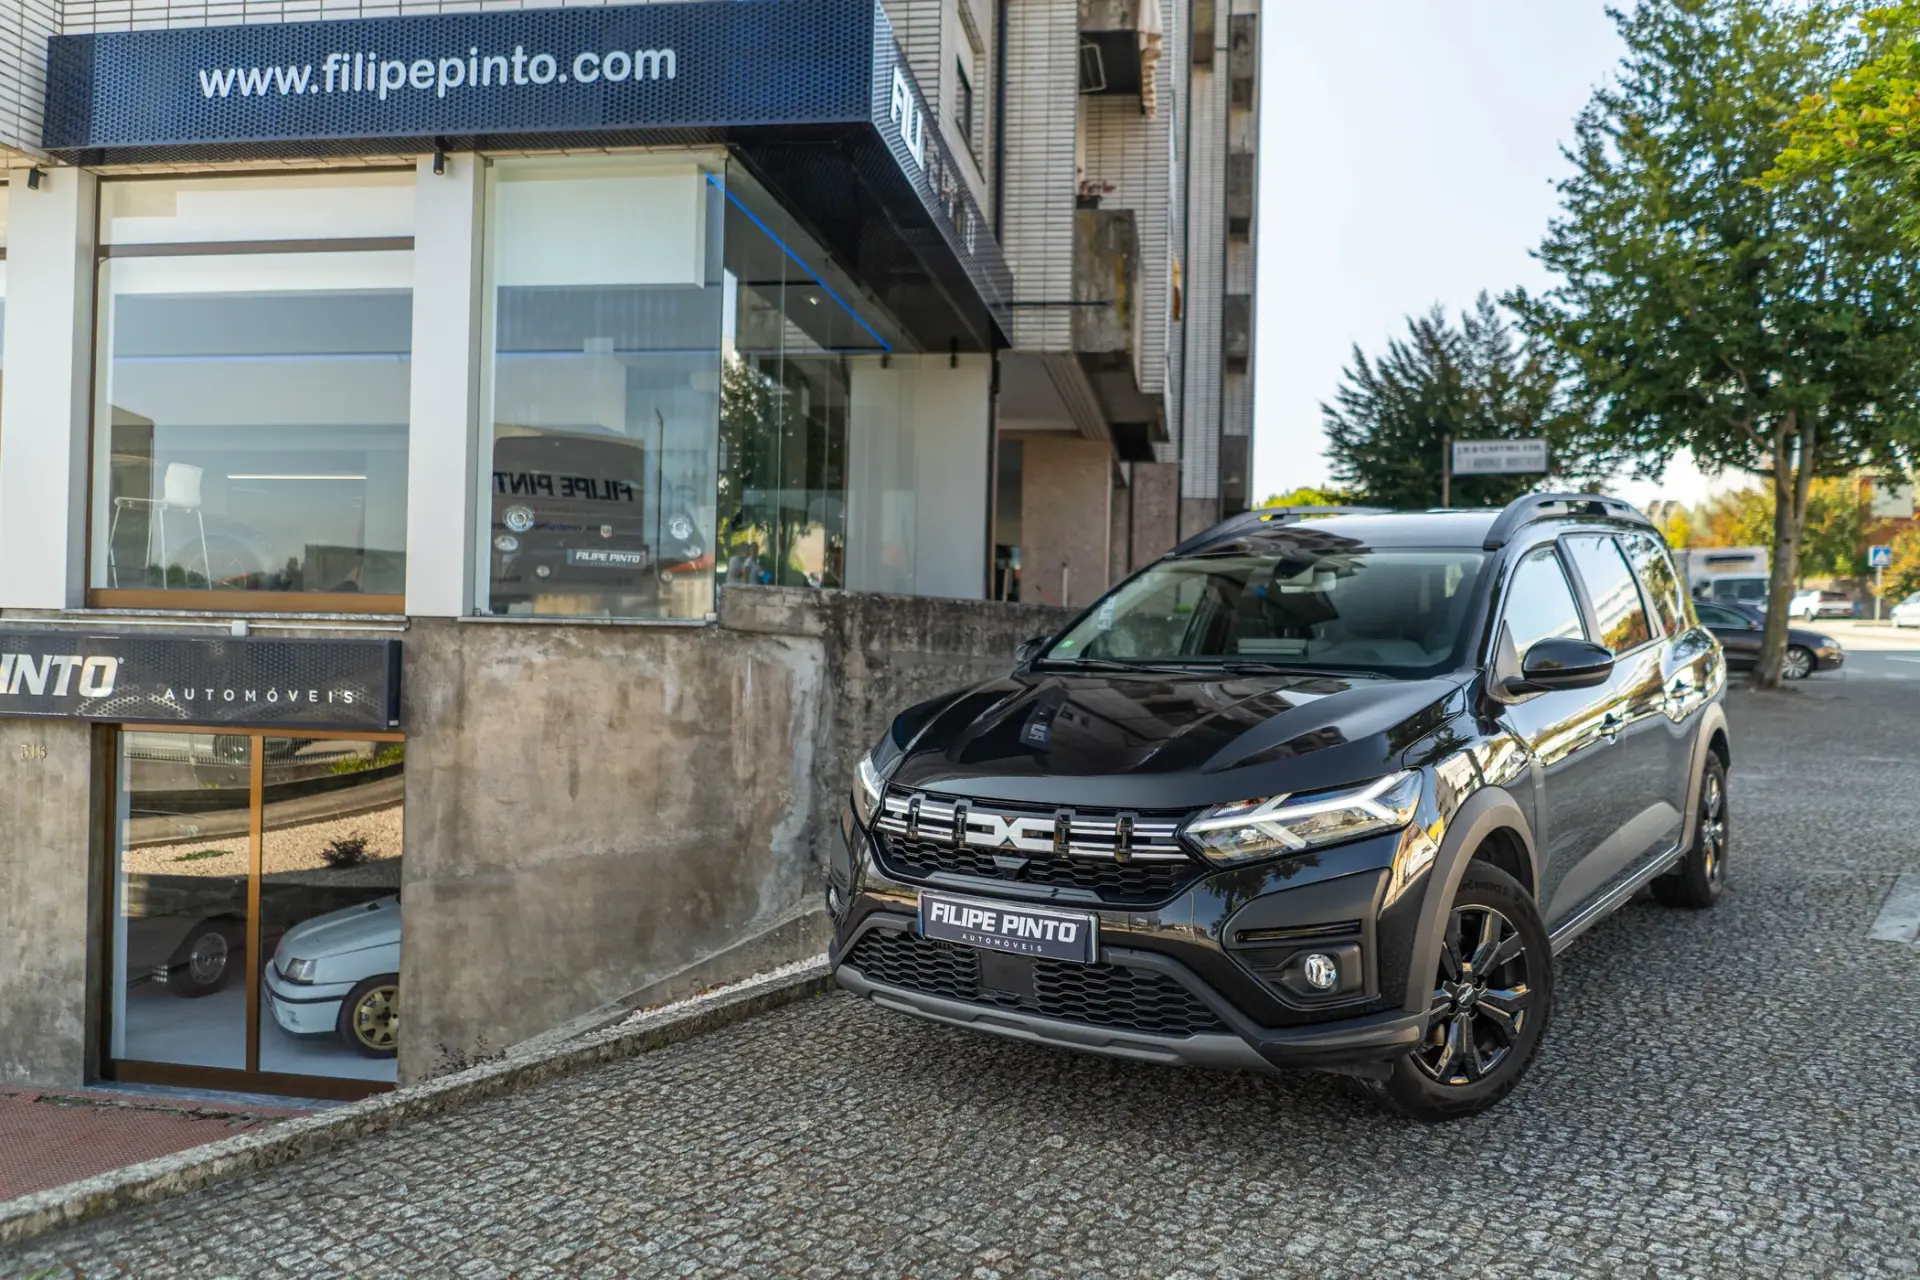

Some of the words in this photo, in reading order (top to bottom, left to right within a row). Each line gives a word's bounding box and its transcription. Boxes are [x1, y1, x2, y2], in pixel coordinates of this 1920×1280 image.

[199, 45, 677, 100] www.filipepinto.com
[575, 551, 607, 562] FILIPE
[609, 553, 640, 564] PINTO
[164, 686, 354, 704] AUTOMÓVEIS
[930, 902, 997, 932] FILIPE
[1001, 914, 1078, 943] PINTO
[962, 933, 1043, 952] AUTOMÓVEIS
